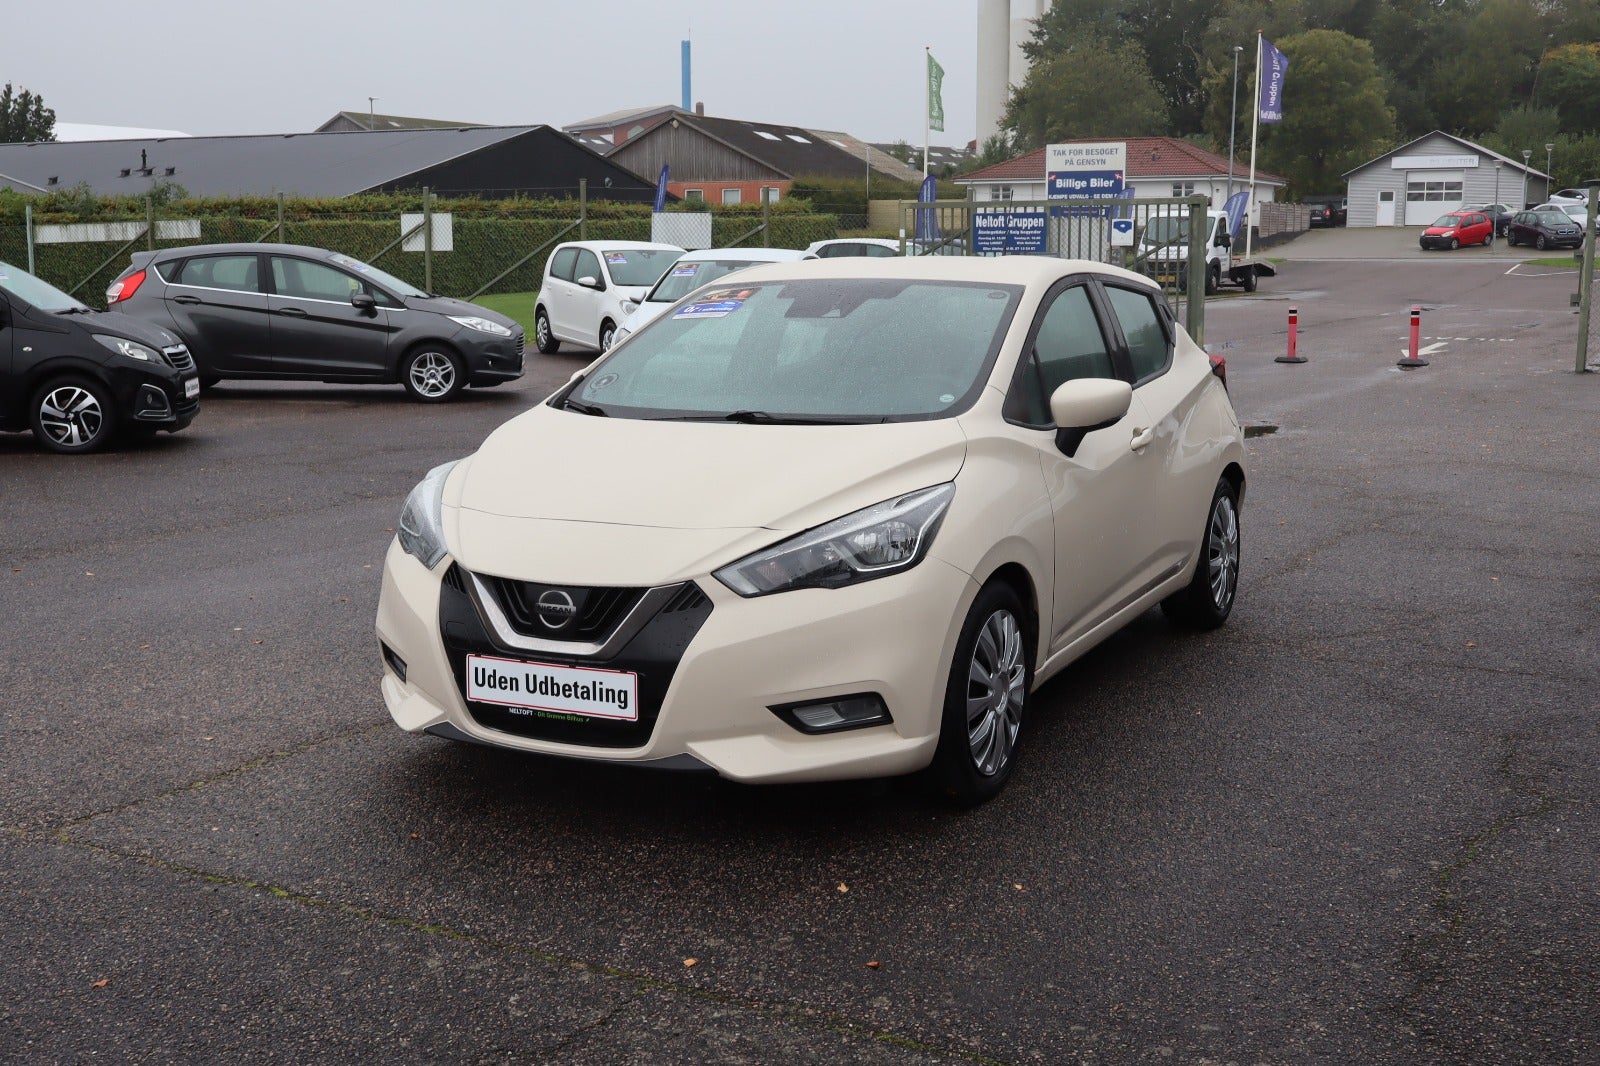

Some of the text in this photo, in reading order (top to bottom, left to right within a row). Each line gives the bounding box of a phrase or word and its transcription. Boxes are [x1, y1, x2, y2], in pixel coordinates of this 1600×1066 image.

[1053, 149, 1067, 157] TAK
[1085, 148, 1119, 156] BESØGET
[1064, 158, 1106, 166] PÅ GENSYN
[1055, 178, 1115, 189] Billige Biler
[975, 215, 1044, 230] Neltoft Gruppen
[537, 604, 571, 614] NISSAN
[474, 667, 628, 710] Uden Udbetaling
[508, 707, 534, 716] NELTOFT
